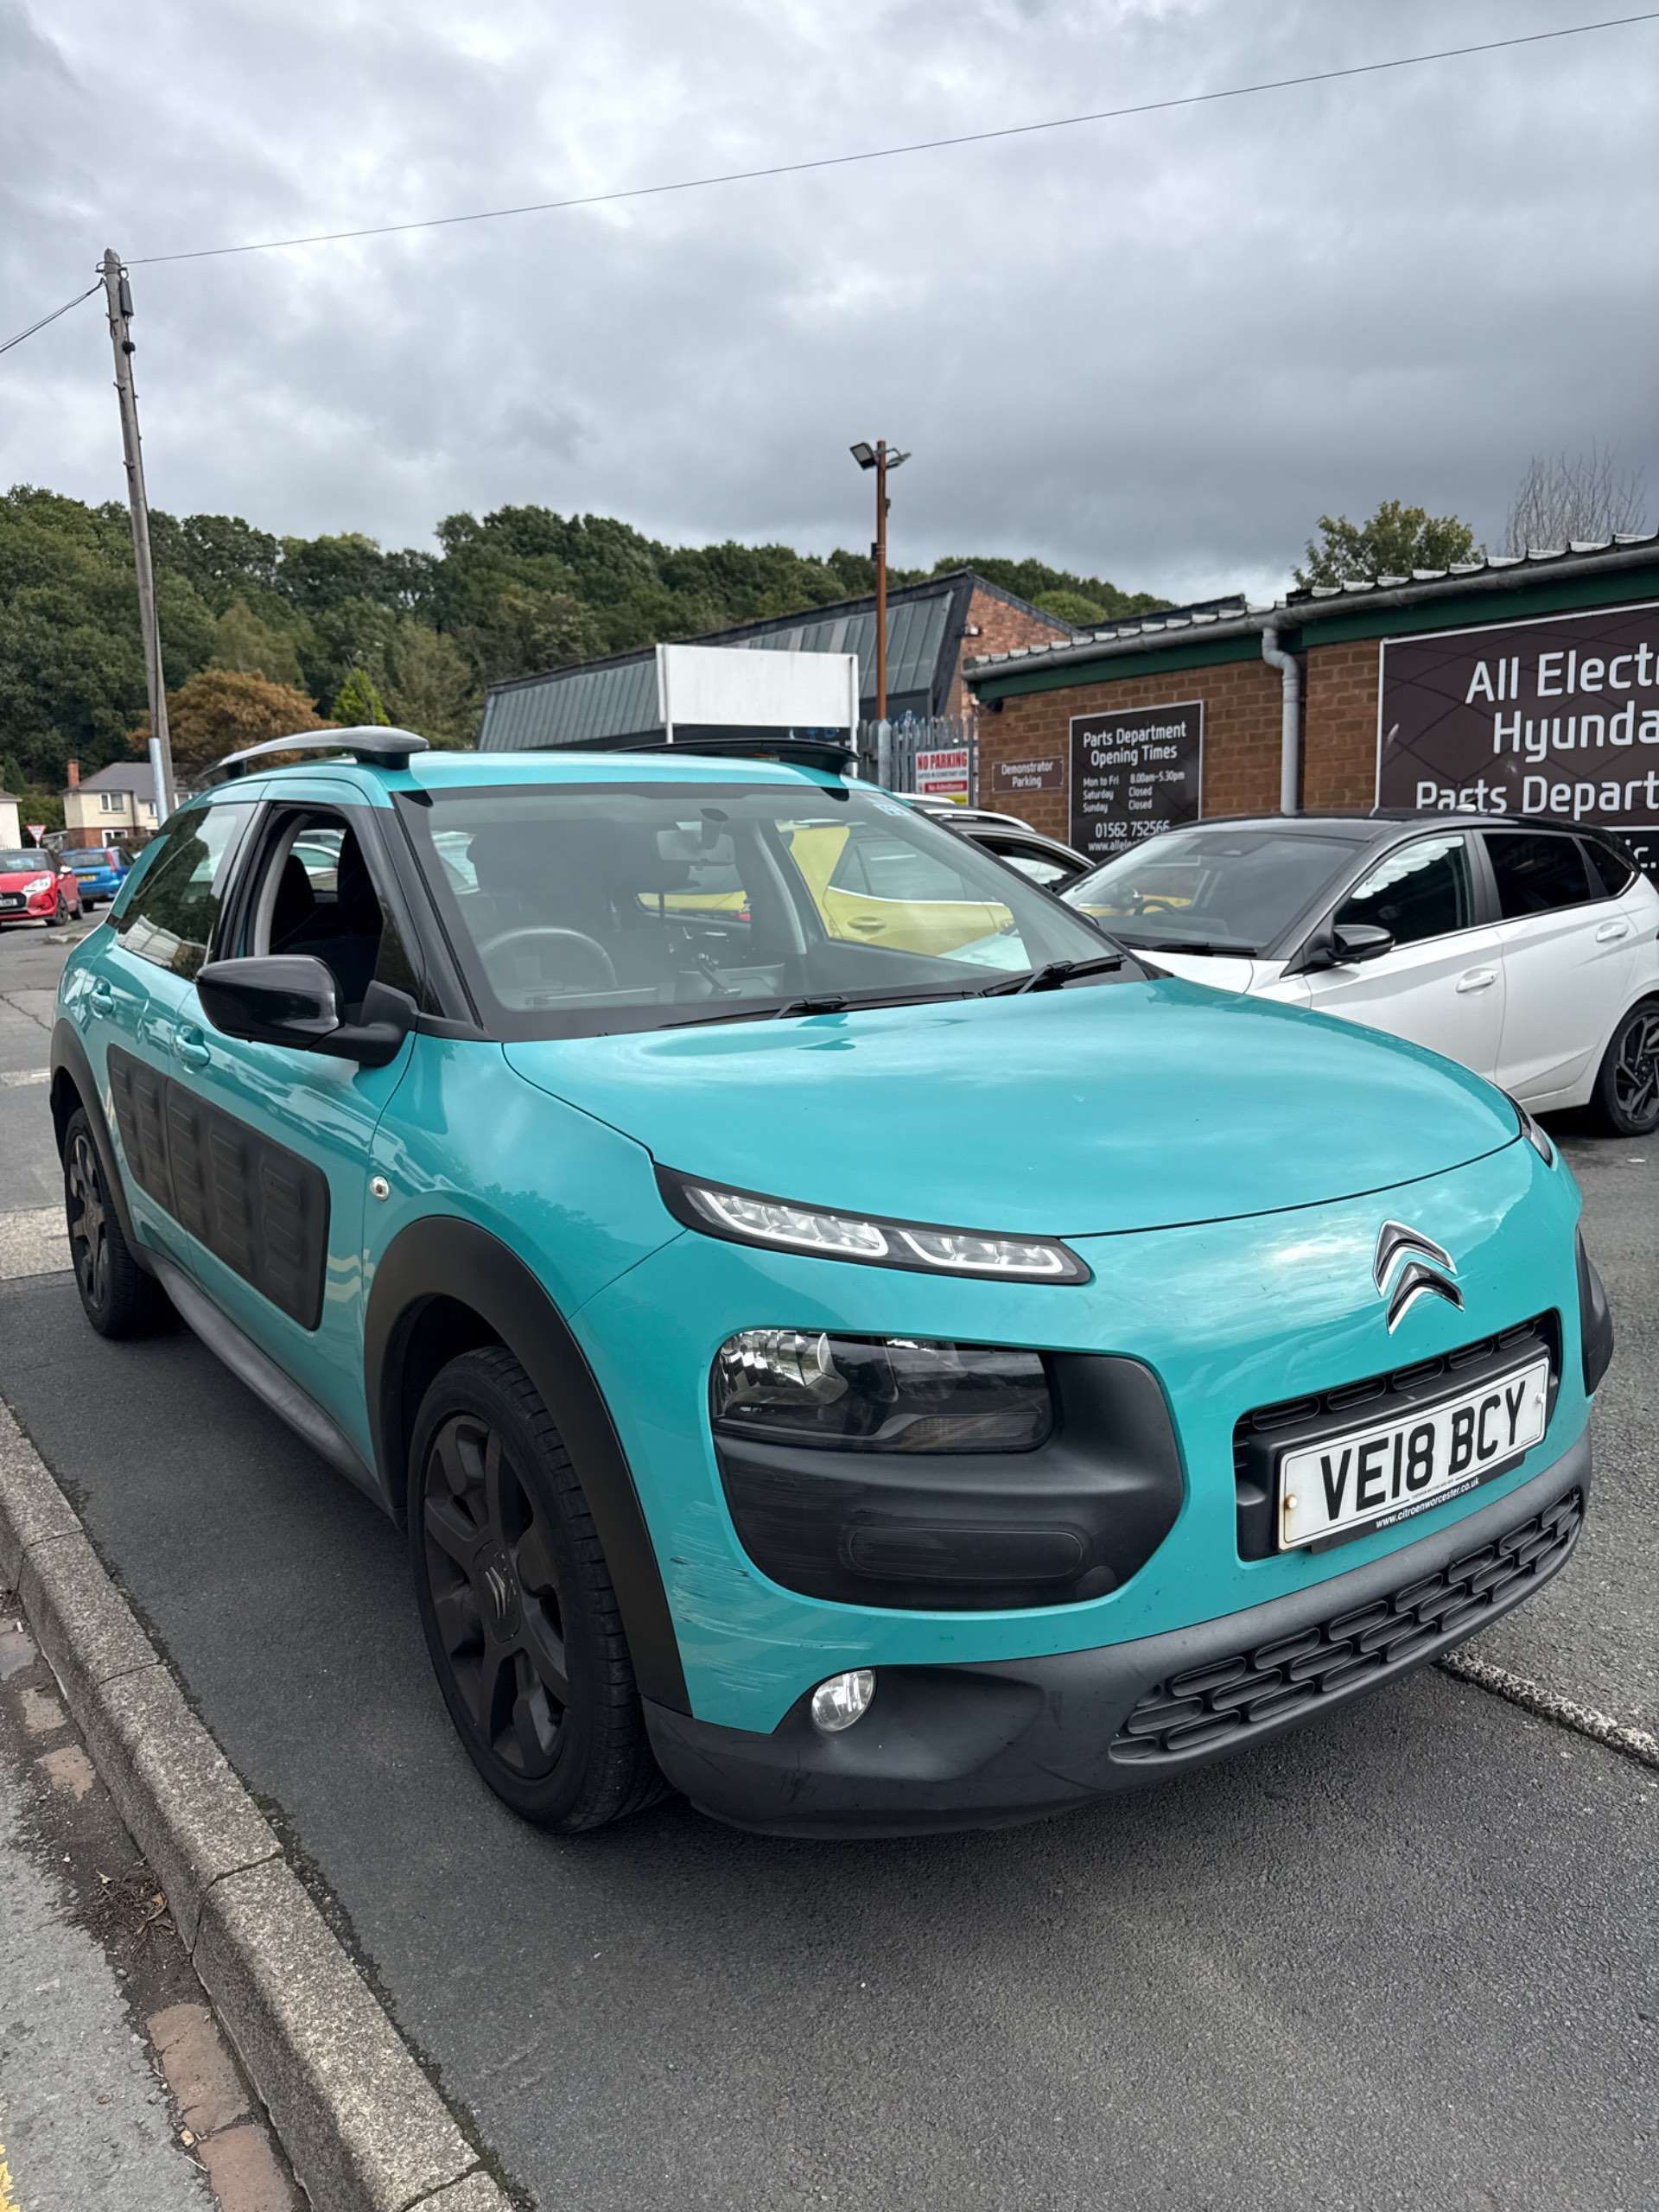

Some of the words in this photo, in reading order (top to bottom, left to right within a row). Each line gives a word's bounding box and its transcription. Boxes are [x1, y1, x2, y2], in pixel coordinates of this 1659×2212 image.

[1465, 657, 1519, 704] All
[1537, 642, 1659, 697] Elect
[1084, 730, 1113, 747] Parts
[1116, 721, 1186, 746] Department
[918, 753, 928, 770] NO
[931, 751, 967, 769] PARKING
[1090, 748, 1138, 768] Opening
[1141, 745, 1177, 761] Times
[1001, 760, 1053, 775] Demonstrator
[1012, 776, 1041, 788] Parking
[1083, 778, 1098, 787] Mon
[1100, 777, 1107, 786] to
[1109, 775, 1120, 785] Fri
[1083, 790, 1114, 801] Saturday
[1128, 785, 1153, 798] Closed
[1415, 779, 1508, 814] Parts
[1083, 802, 1108, 814] Sunday
[1128, 798, 1153, 810] Closed
[1095, 822, 1127, 838] 01562
[1320, 1421, 1435, 1521] VE18
[1448, 1380, 1527, 1476] BCY
[1376, 1476, 1480, 1529] www.citroenworcester.co.uk
